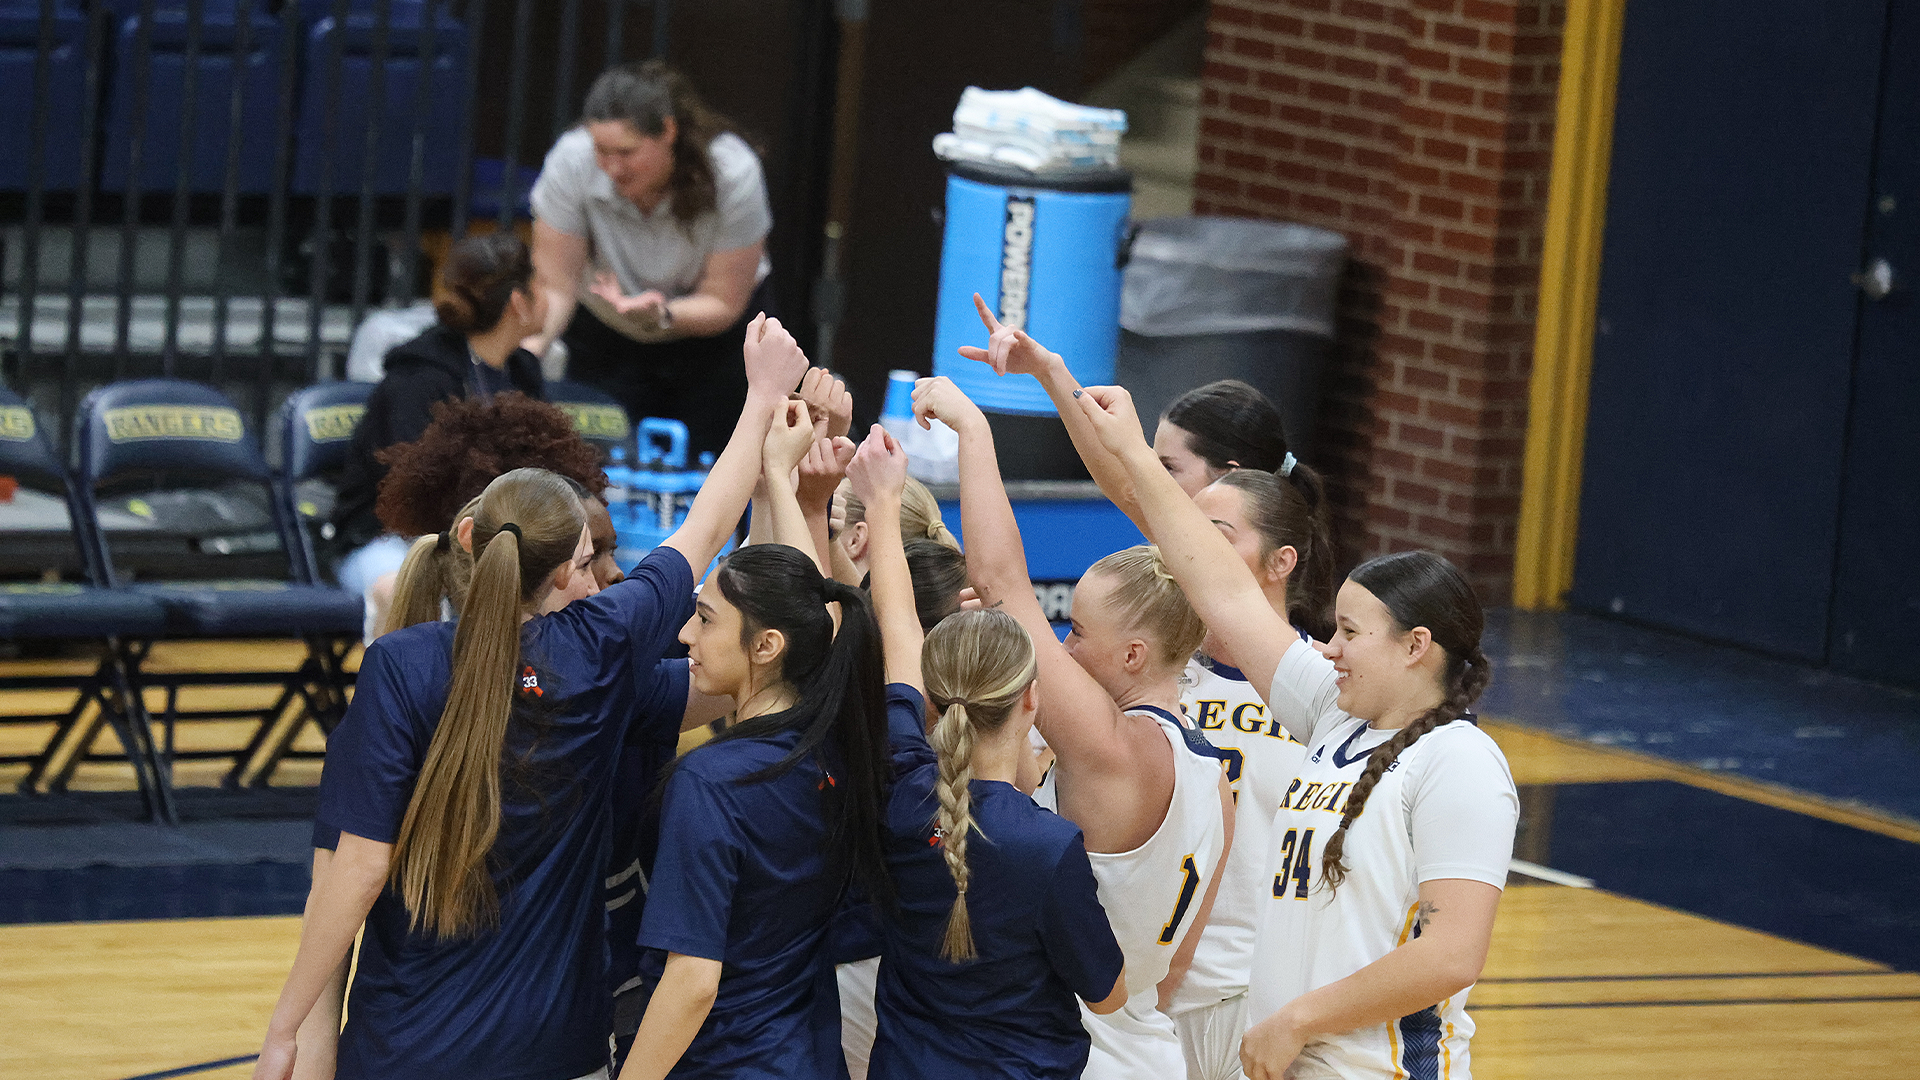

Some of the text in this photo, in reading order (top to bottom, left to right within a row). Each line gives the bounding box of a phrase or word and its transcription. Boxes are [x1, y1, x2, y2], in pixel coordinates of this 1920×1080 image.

[110, 412, 241, 437] RANGERS
[522, 675, 538, 688] 33
[1179, 699, 1305, 746] EGI
[1272, 827, 1316, 901] 34
[1156, 852, 1200, 946] 1
